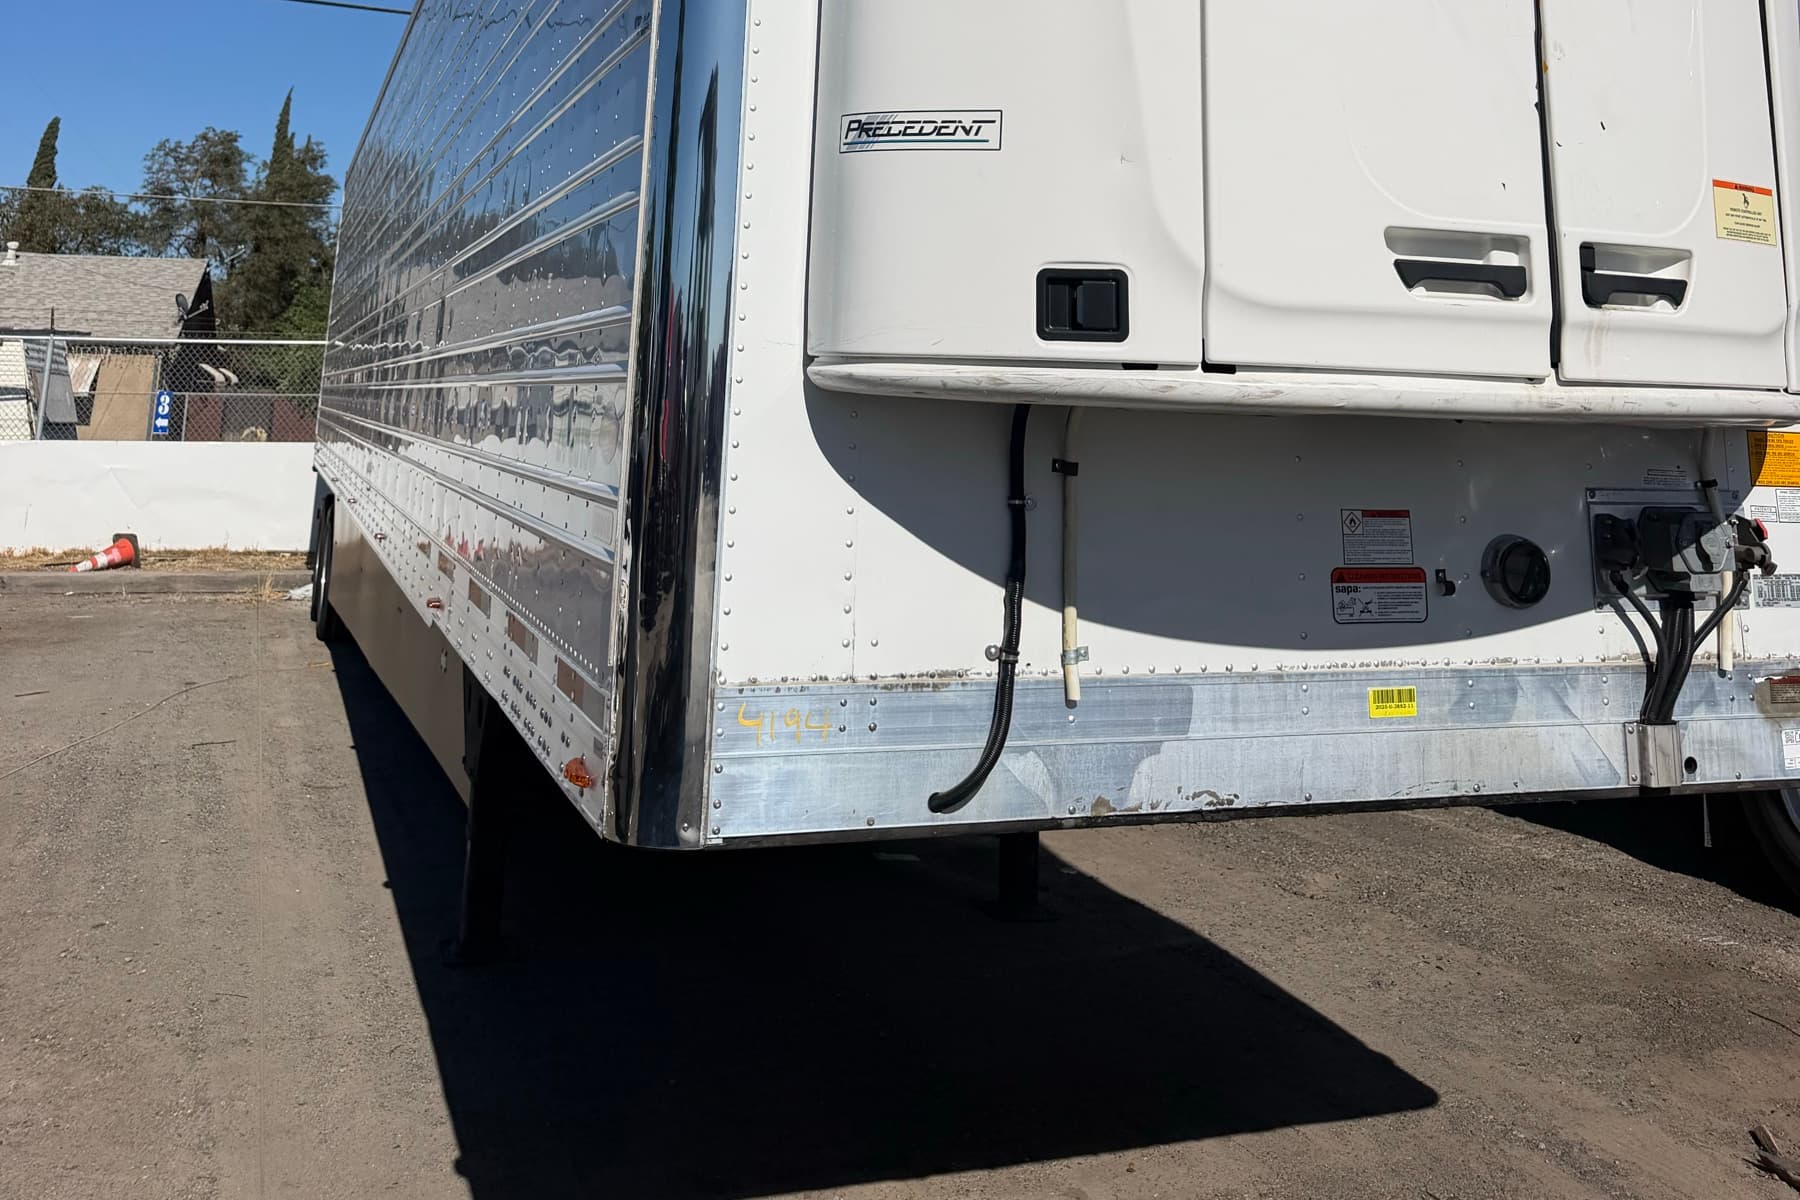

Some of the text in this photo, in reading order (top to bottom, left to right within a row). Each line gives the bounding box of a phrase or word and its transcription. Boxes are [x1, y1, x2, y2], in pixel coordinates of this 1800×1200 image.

[844, 118, 996, 140] PRECEDENT
[158, 395, 170, 415] 3
[737, 702, 832, 746] 4194
